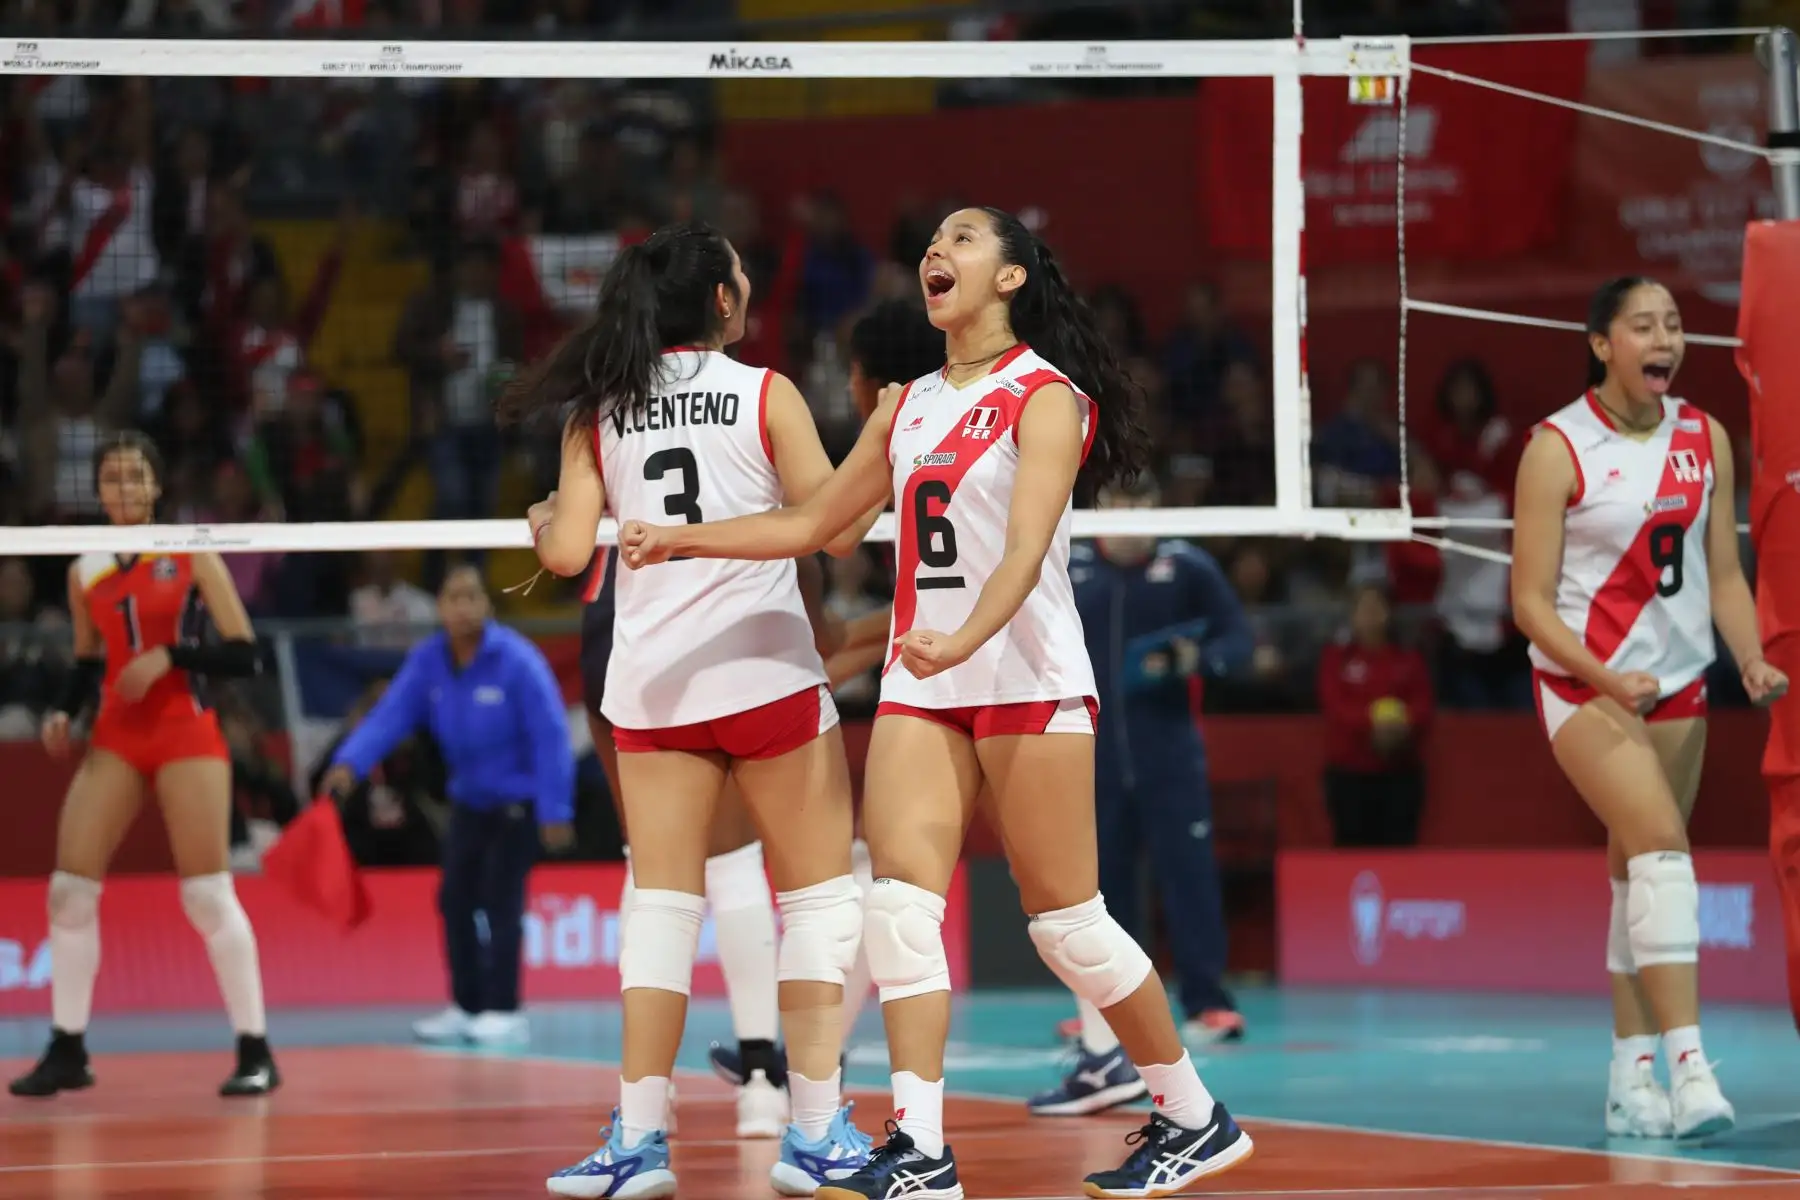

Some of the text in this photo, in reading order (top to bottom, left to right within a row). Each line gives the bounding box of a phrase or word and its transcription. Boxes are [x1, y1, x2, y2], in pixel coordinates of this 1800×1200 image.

[611, 391, 740, 439] V.CENTENO
[961, 428, 992, 440] PER
[643, 447, 703, 562] 3
[914, 479, 958, 569] 6
[1649, 524, 1685, 598] 9
[115, 593, 142, 649] 1
